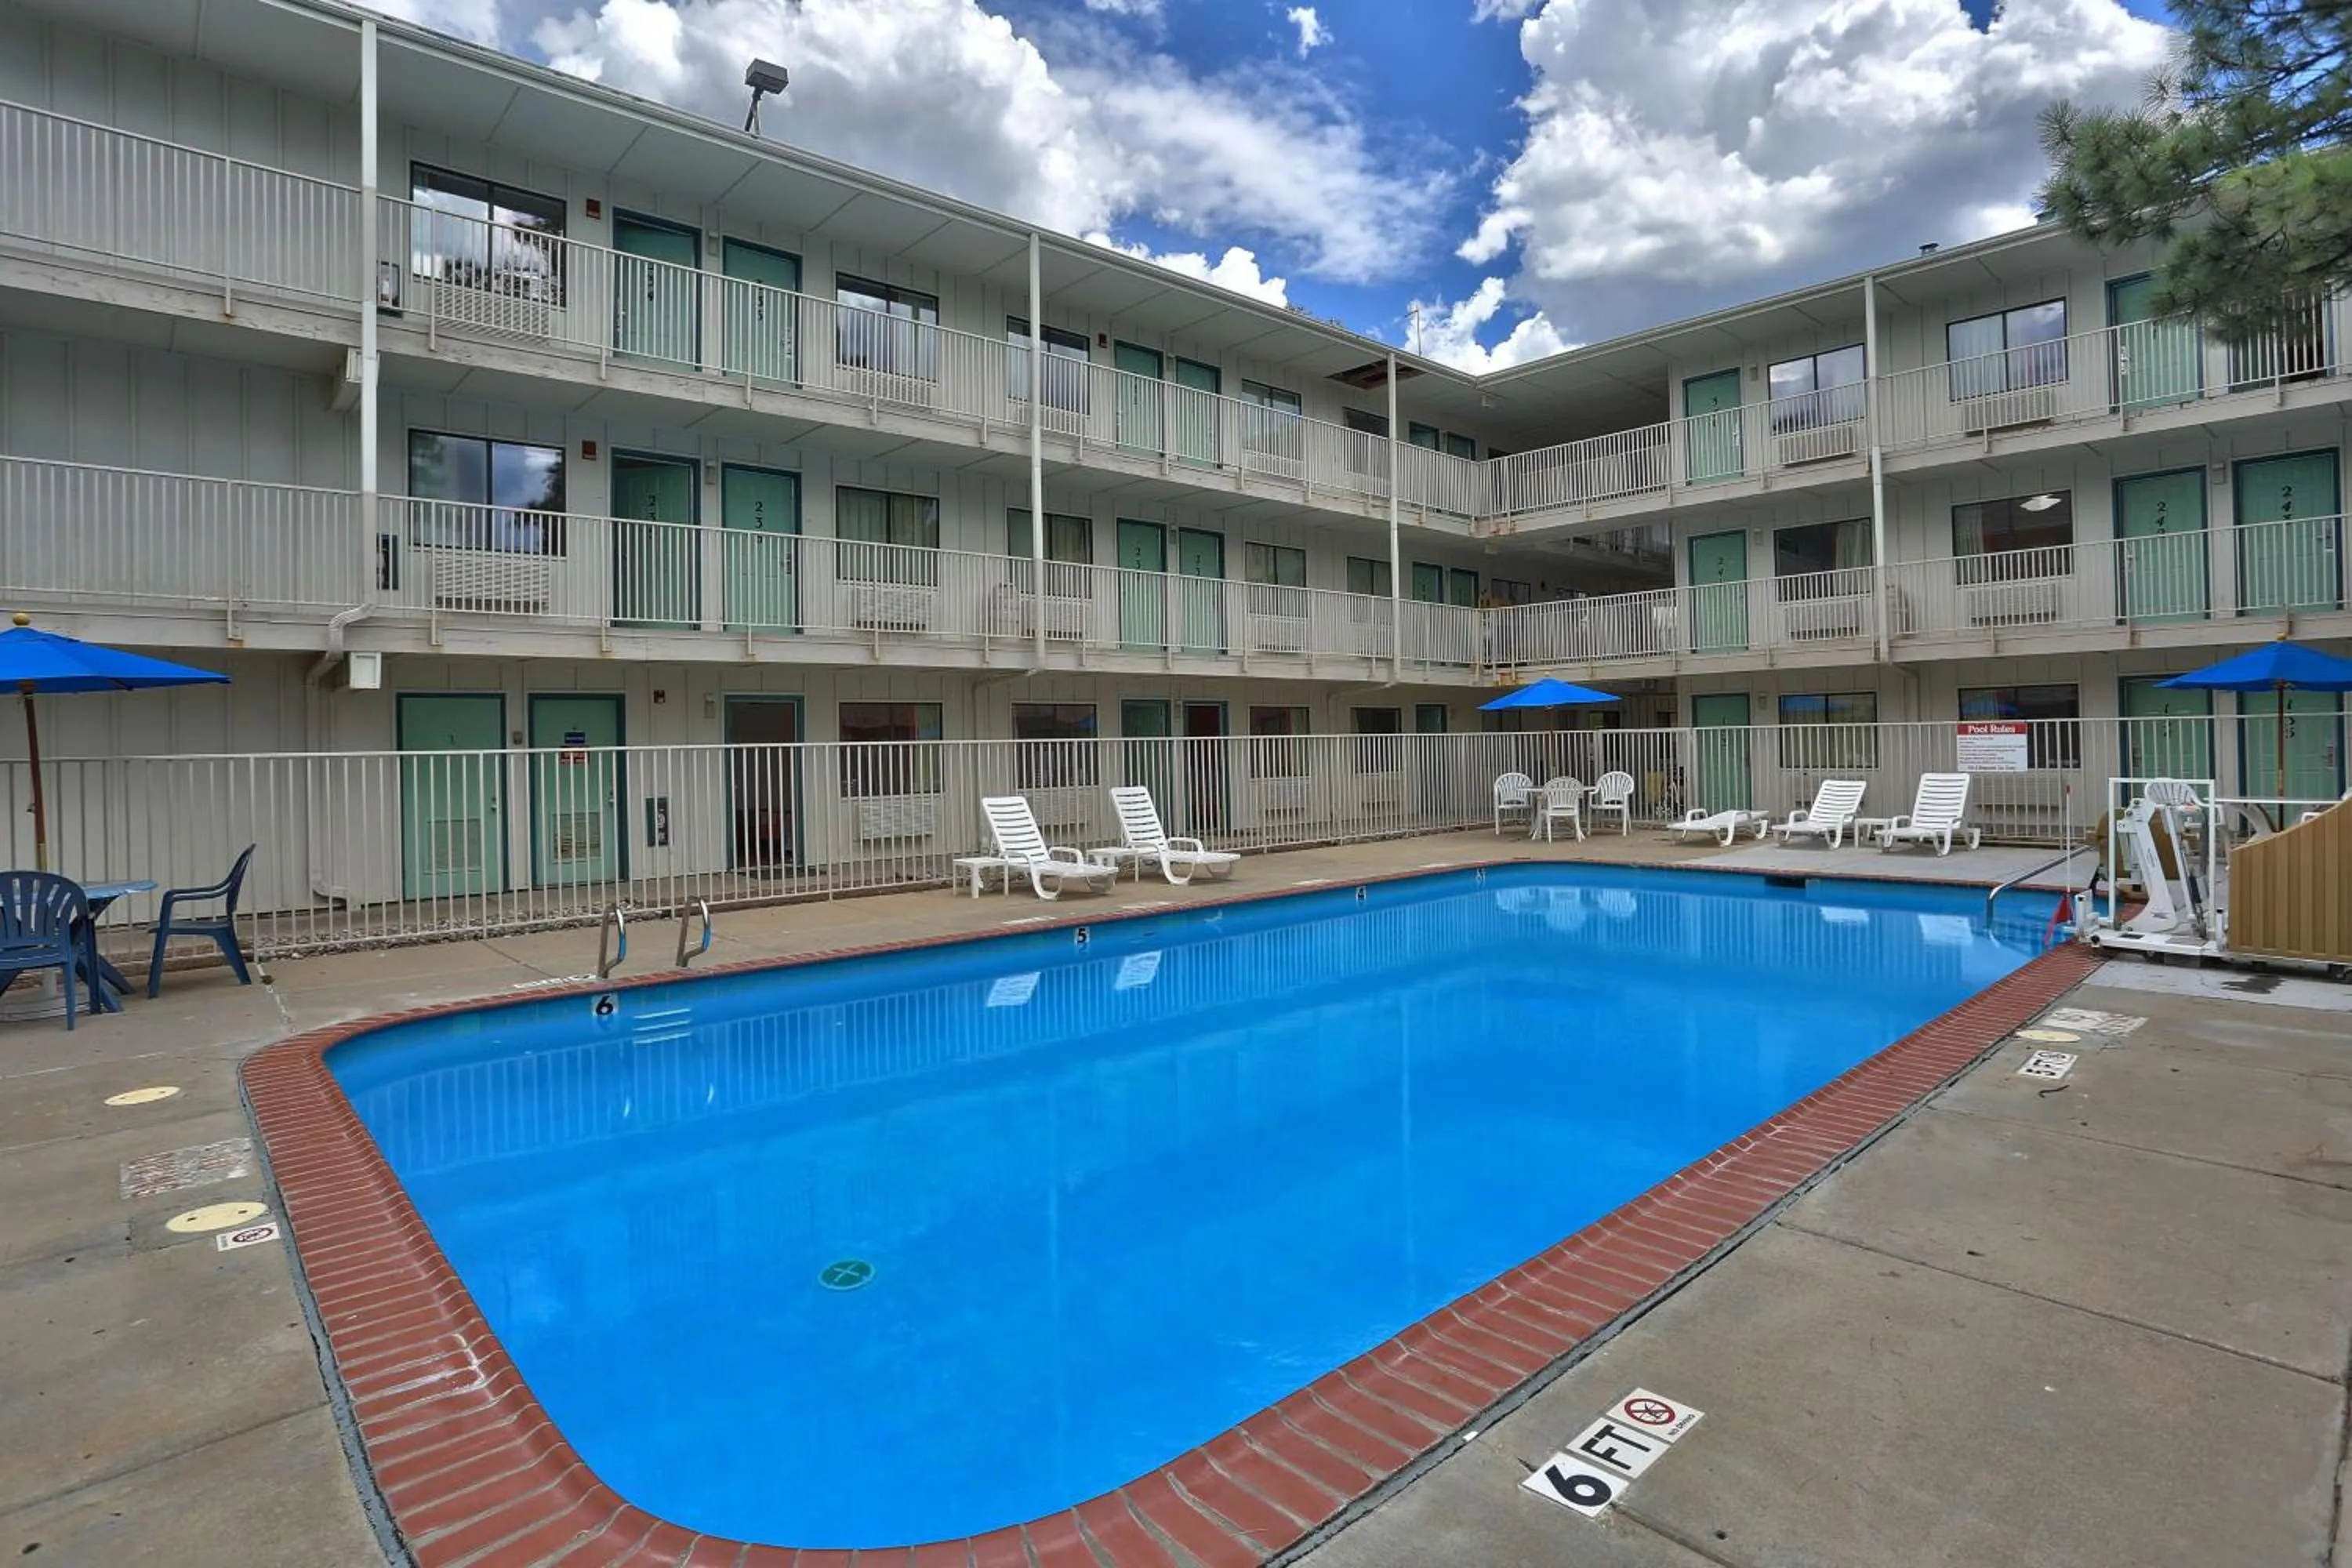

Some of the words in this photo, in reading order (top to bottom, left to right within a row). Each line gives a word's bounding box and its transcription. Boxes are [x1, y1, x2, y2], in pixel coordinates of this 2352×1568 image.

[1967, 724, 1988, 733] Pool
[1990, 724, 2016, 733] Rules
[1077, 927, 1087, 943] 5
[595, 995, 614, 1016] 6
[1544, 1464, 1613, 1507] 6
[1580, 1424, 1652, 1471] FT
